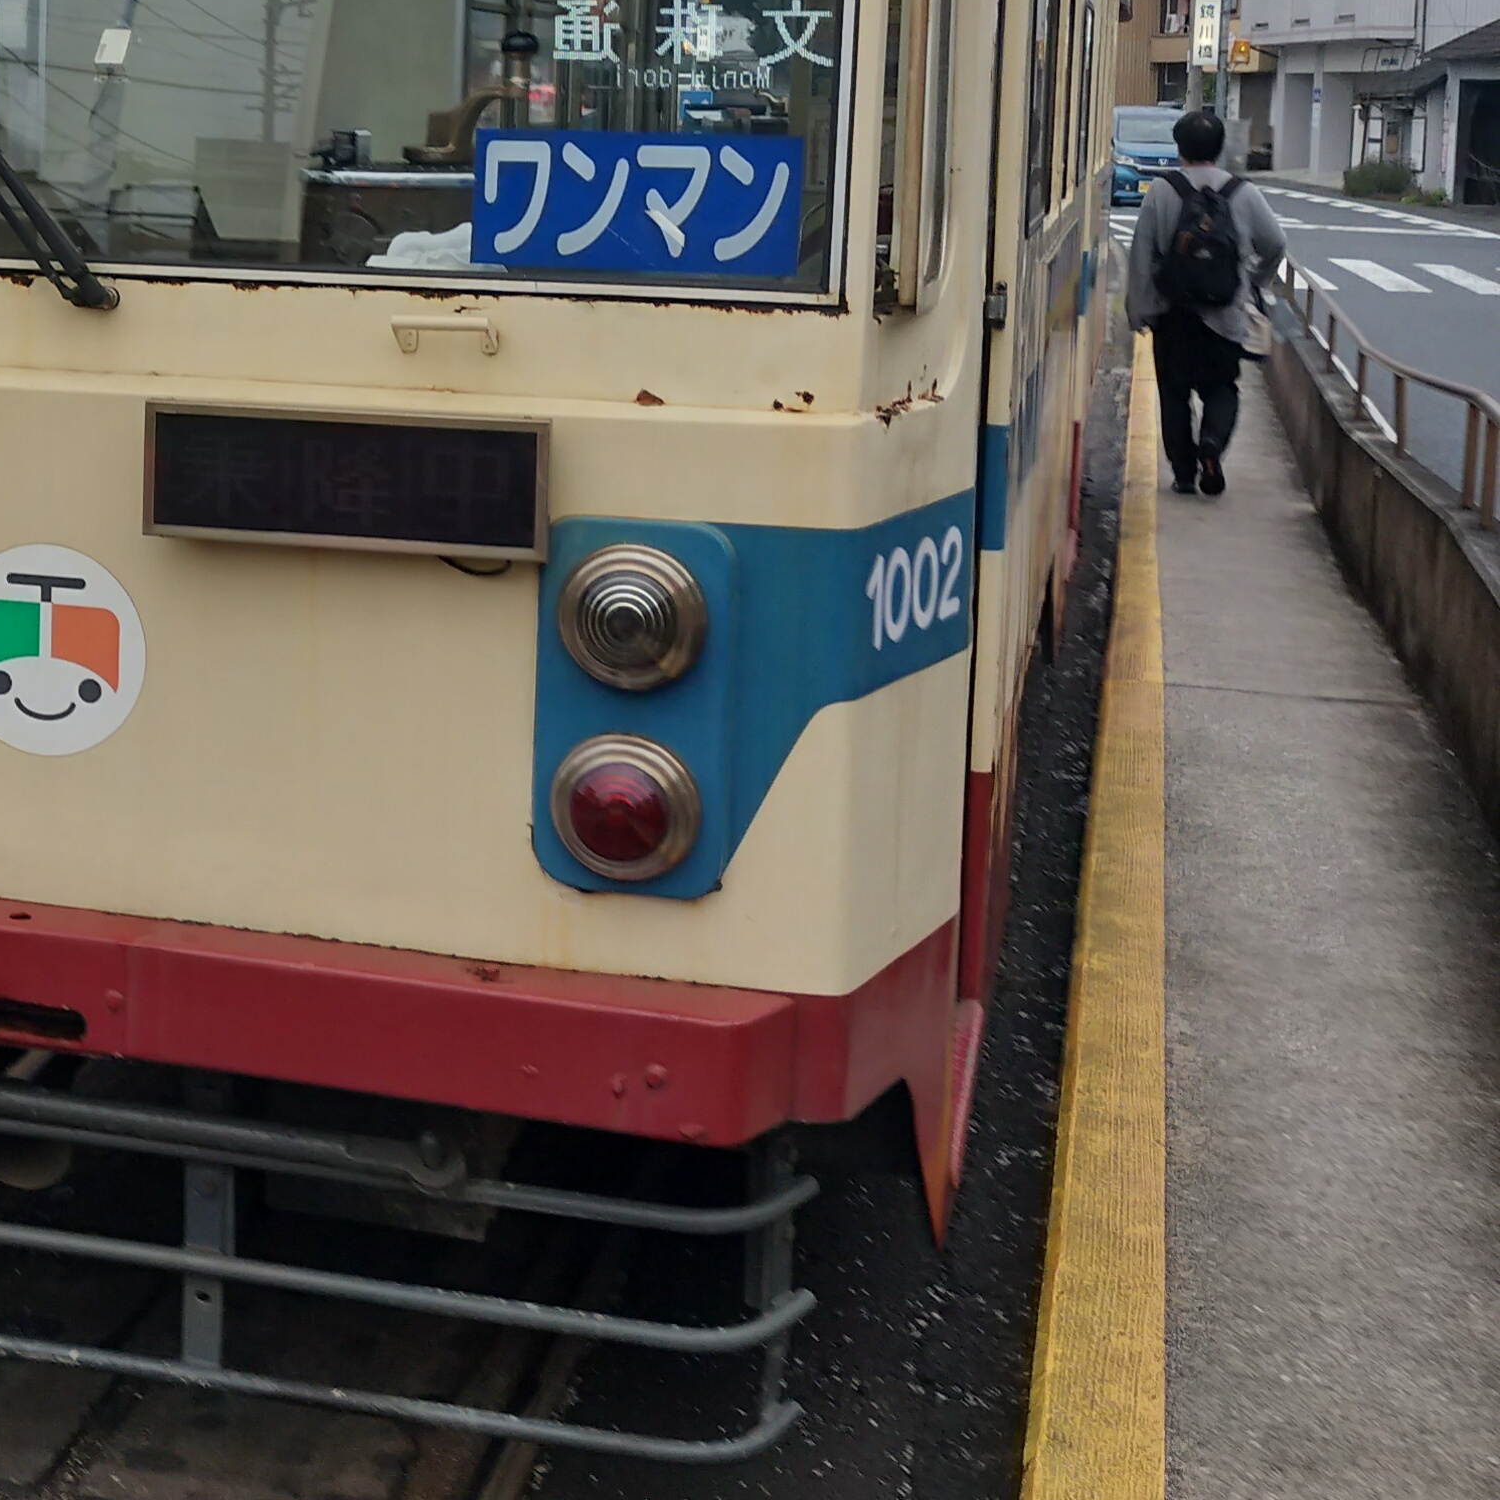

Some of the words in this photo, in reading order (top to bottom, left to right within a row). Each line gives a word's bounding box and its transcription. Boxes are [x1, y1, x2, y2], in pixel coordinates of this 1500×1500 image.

[484, 140, 790, 262] ワンマン
[865, 525, 963, 651] 1002
